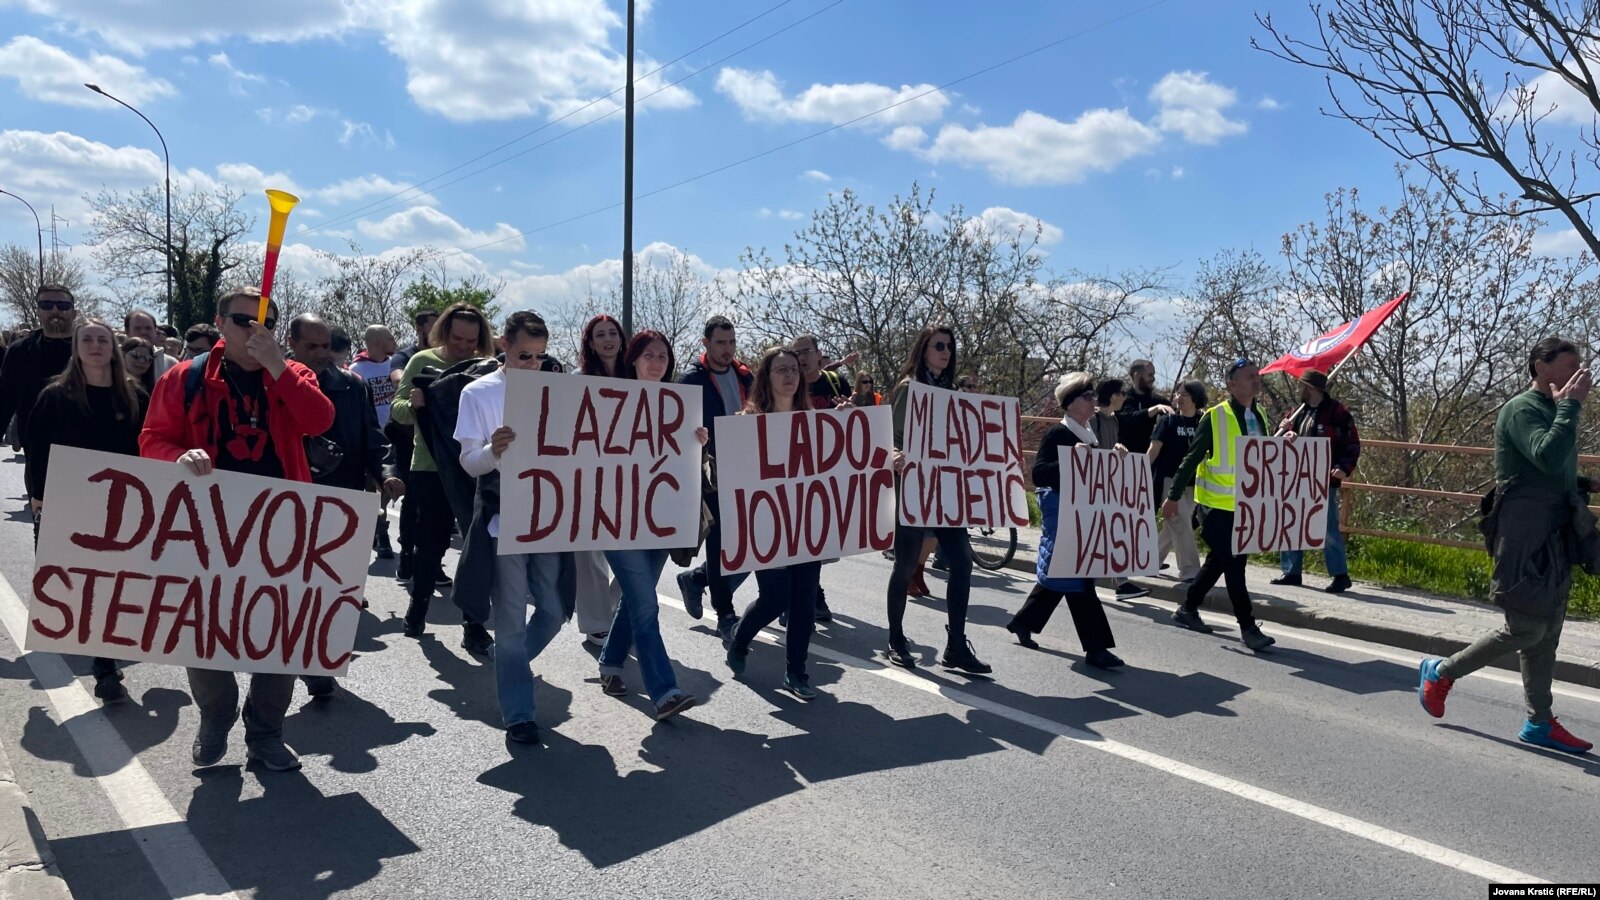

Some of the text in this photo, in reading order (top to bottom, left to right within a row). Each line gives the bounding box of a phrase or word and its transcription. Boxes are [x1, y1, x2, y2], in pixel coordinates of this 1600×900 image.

[537, 385, 684, 457] LAZAR
[757, 409, 871, 480] LADO
[908, 390, 1024, 470] MLADEN
[515, 454, 681, 543] DINIĆ
[901, 461, 1030, 528] CVIJETIĆ
[1071, 446, 1151, 510] MARIJA
[1241, 438, 1330, 502] SRĐAN
[70, 468, 360, 585] DAVOR
[721, 446, 894, 571] JOVOVIĆ
[1074, 502, 1150, 576] VASIĆ
[1234, 496, 1325, 553] ĐURIĆ
[31, 565, 364, 671] STEFANOVIĆ
